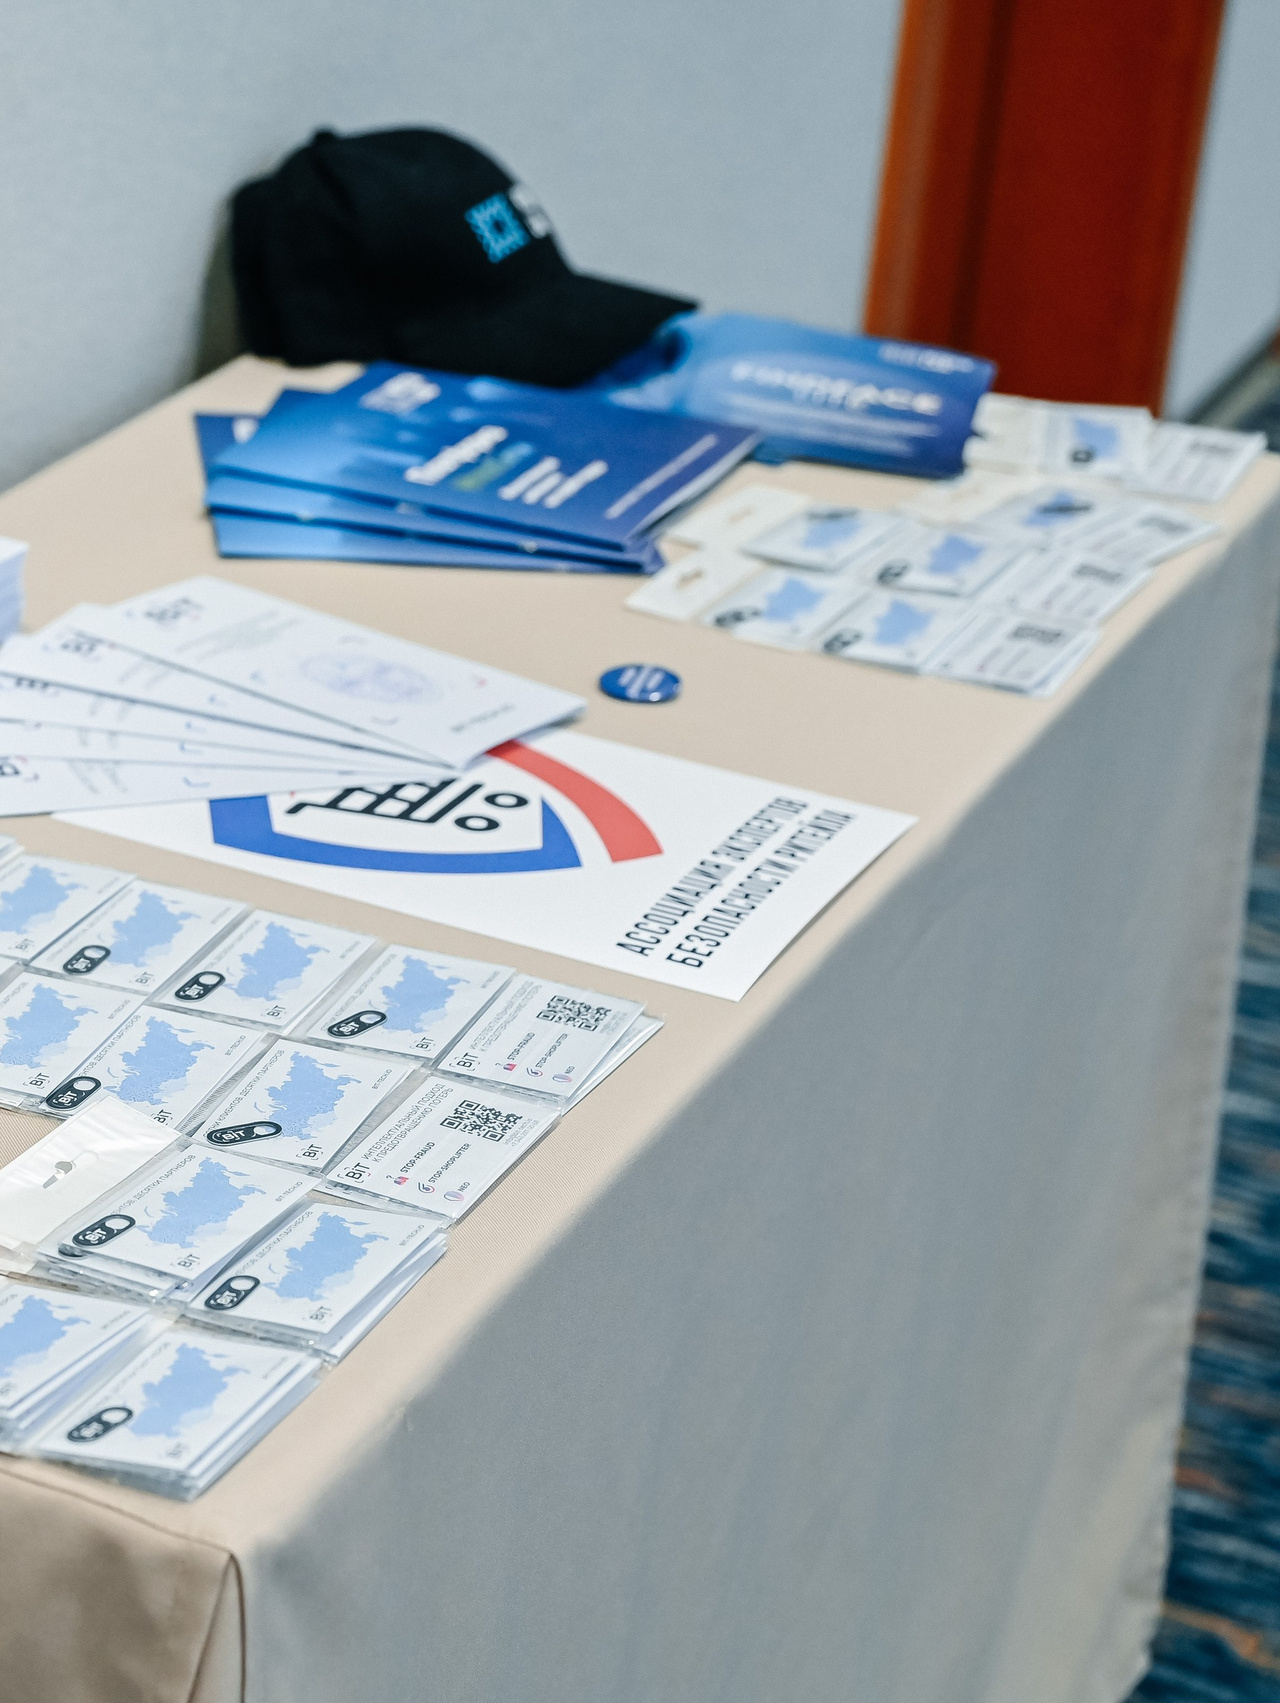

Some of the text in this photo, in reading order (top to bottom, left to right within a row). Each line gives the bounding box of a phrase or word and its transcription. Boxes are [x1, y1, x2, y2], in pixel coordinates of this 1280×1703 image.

[616, 860, 736, 957] АССОЦИАЦИЯ
[666, 857, 800, 968] БЕЗОПАСНОСТИ
[361, 1083, 446, 1160] ИНТЕЛЛЕКТУАЛЬНЫЙ ПОДХОД
[376, 1107, 433, 1158] ПРЕДОТВРАЩЕНИЮ
[428, 1087, 454, 1108] ПОТЕРЬ
[399, 1141, 435, 1174] STOP-FRAUD
[428, 1143, 471, 1184] STOP-SHOPLIFTER
[457, 1181, 471, 1192] NEO
